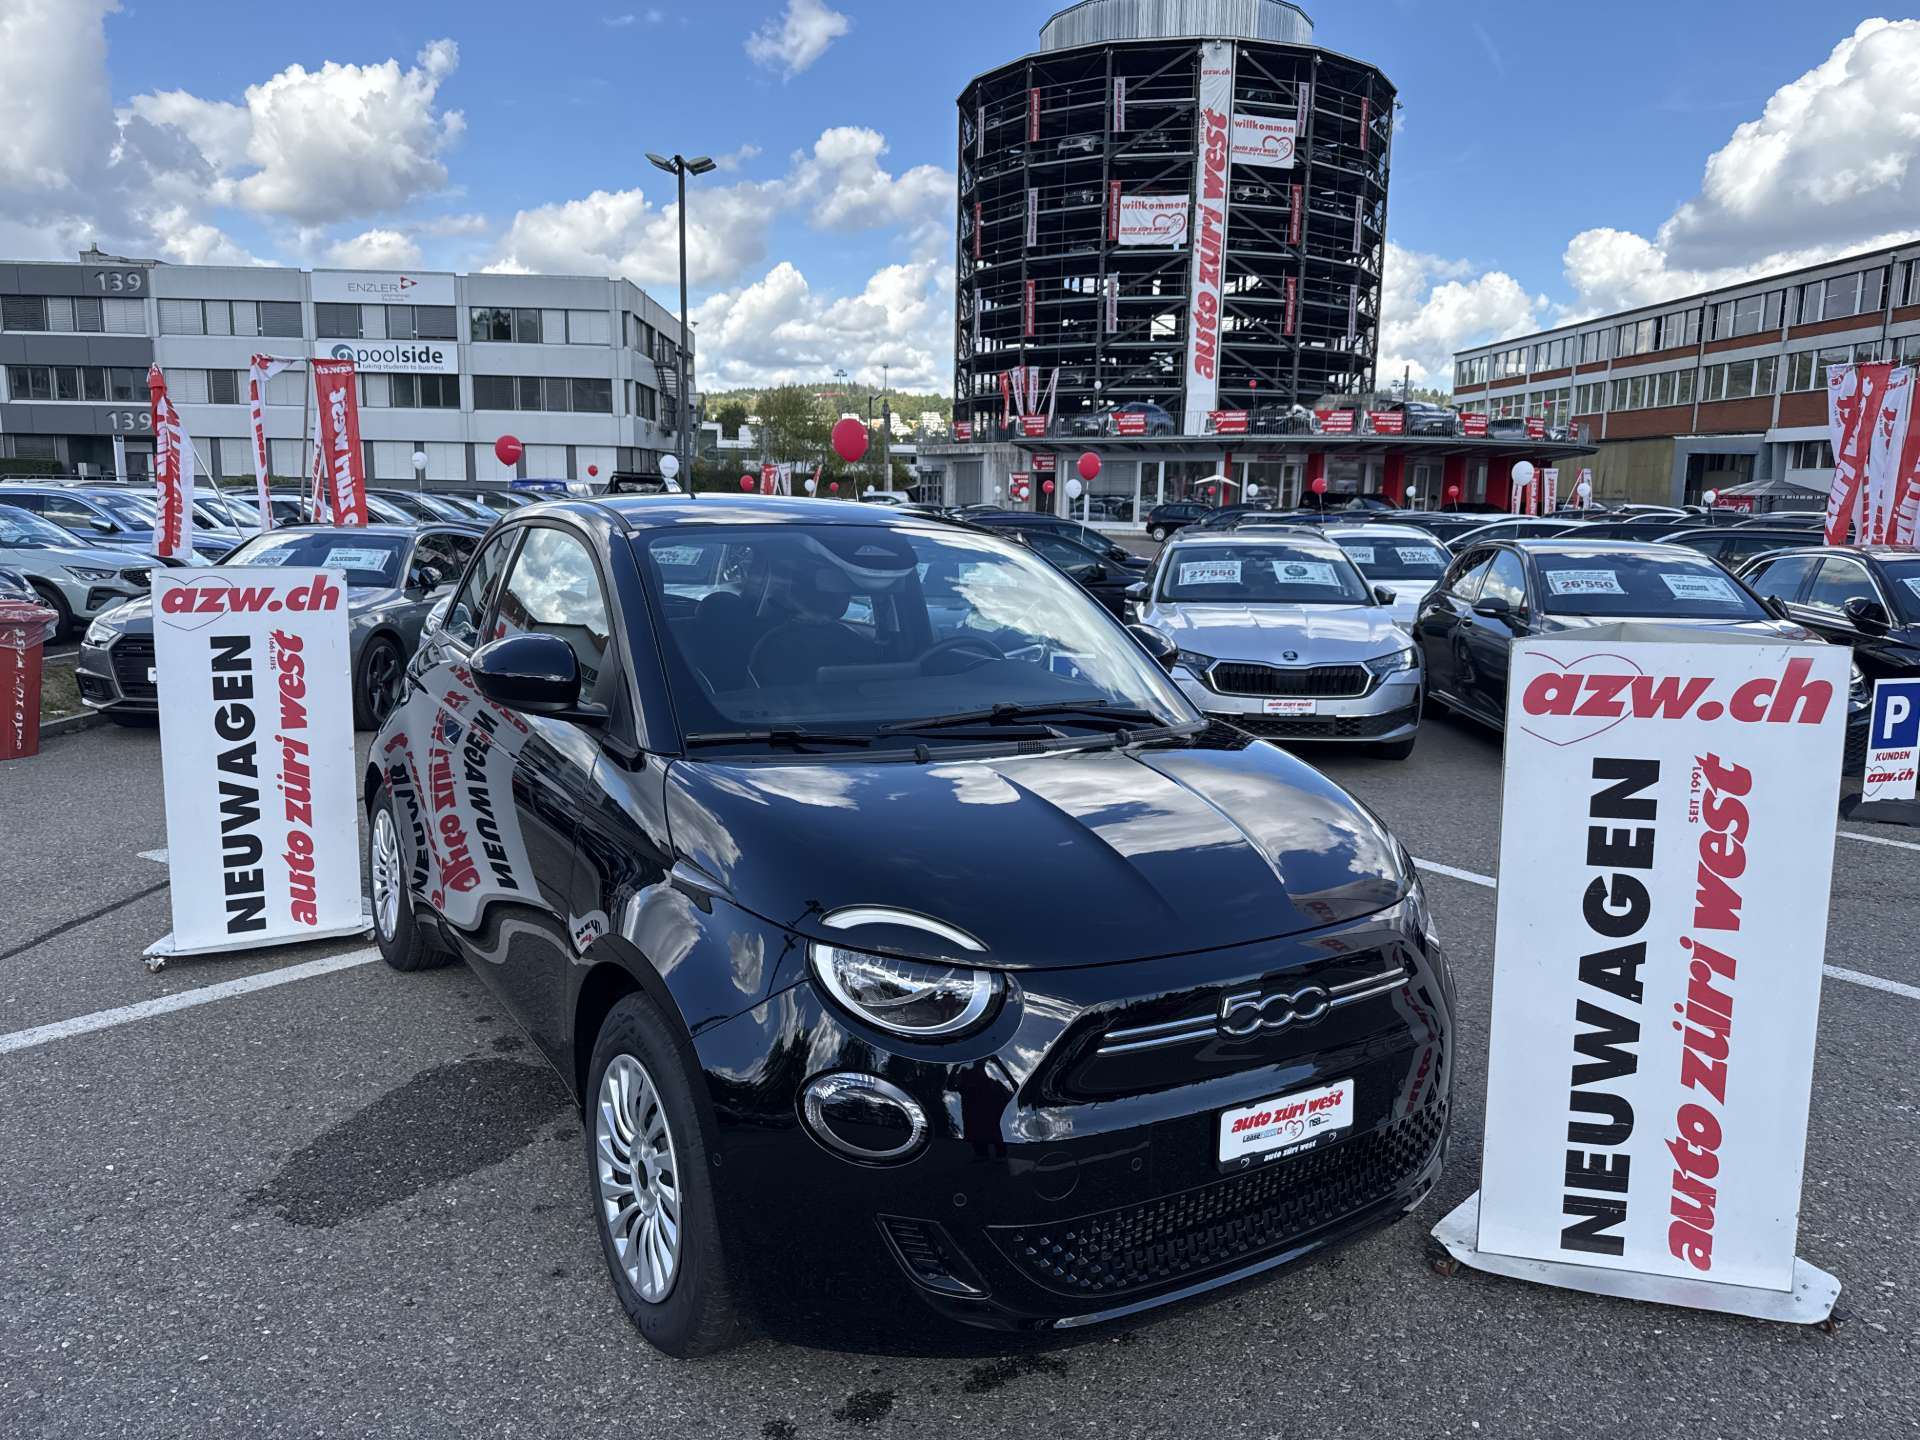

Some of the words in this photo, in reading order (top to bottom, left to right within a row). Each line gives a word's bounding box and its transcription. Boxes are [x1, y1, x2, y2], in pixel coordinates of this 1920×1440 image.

[1202, 67, 1231, 76] azw.ch
[1234, 119, 1294, 133] willkommen
[1203, 107, 1228, 199] west
[1122, 201, 1187, 209] willkommen
[1195, 203, 1223, 290] züri
[94, 271, 141, 291] 139
[348, 282, 399, 293] ENZLER
[1194, 291, 1218, 380] auto
[357, 345, 443, 369] poolside
[107, 412, 152, 431] 139
[161, 574, 340, 614] azw.ch
[1189, 569, 1236, 578] 27'550
[1561, 579, 1614, 590] 26'550
[273, 629, 308, 730] west
[1521, 656, 1834, 726] azw.ch
[1882, 695, 1911, 740] P
[1866, 767, 1915, 784] azw.ch
[1875, 750, 1912, 762] KUNDEN
[210, 635, 267, 934] NEUWAGEN
[274, 734, 314, 829] züri
[1691, 766, 1702, 794] 1991
[1688, 799, 1699, 824] SEIT
[1692, 751, 1754, 932] west
[280, 829, 318, 927] auto
[1222, 986, 1328, 1035] 500
[1559, 756, 1661, 1257] NEUWAGEN
[1671, 935, 1737, 1107] züri
[1231, 1110, 1272, 1133] auto
[1272, 1099, 1307, 1123] züri
[1308, 1089, 1344, 1112] west
[1263, 1151, 1282, 1162] auto
[1282, 1144, 1300, 1156] züri
[1299, 1140, 1317, 1151] west
[1663, 1102, 1724, 1272] auto
